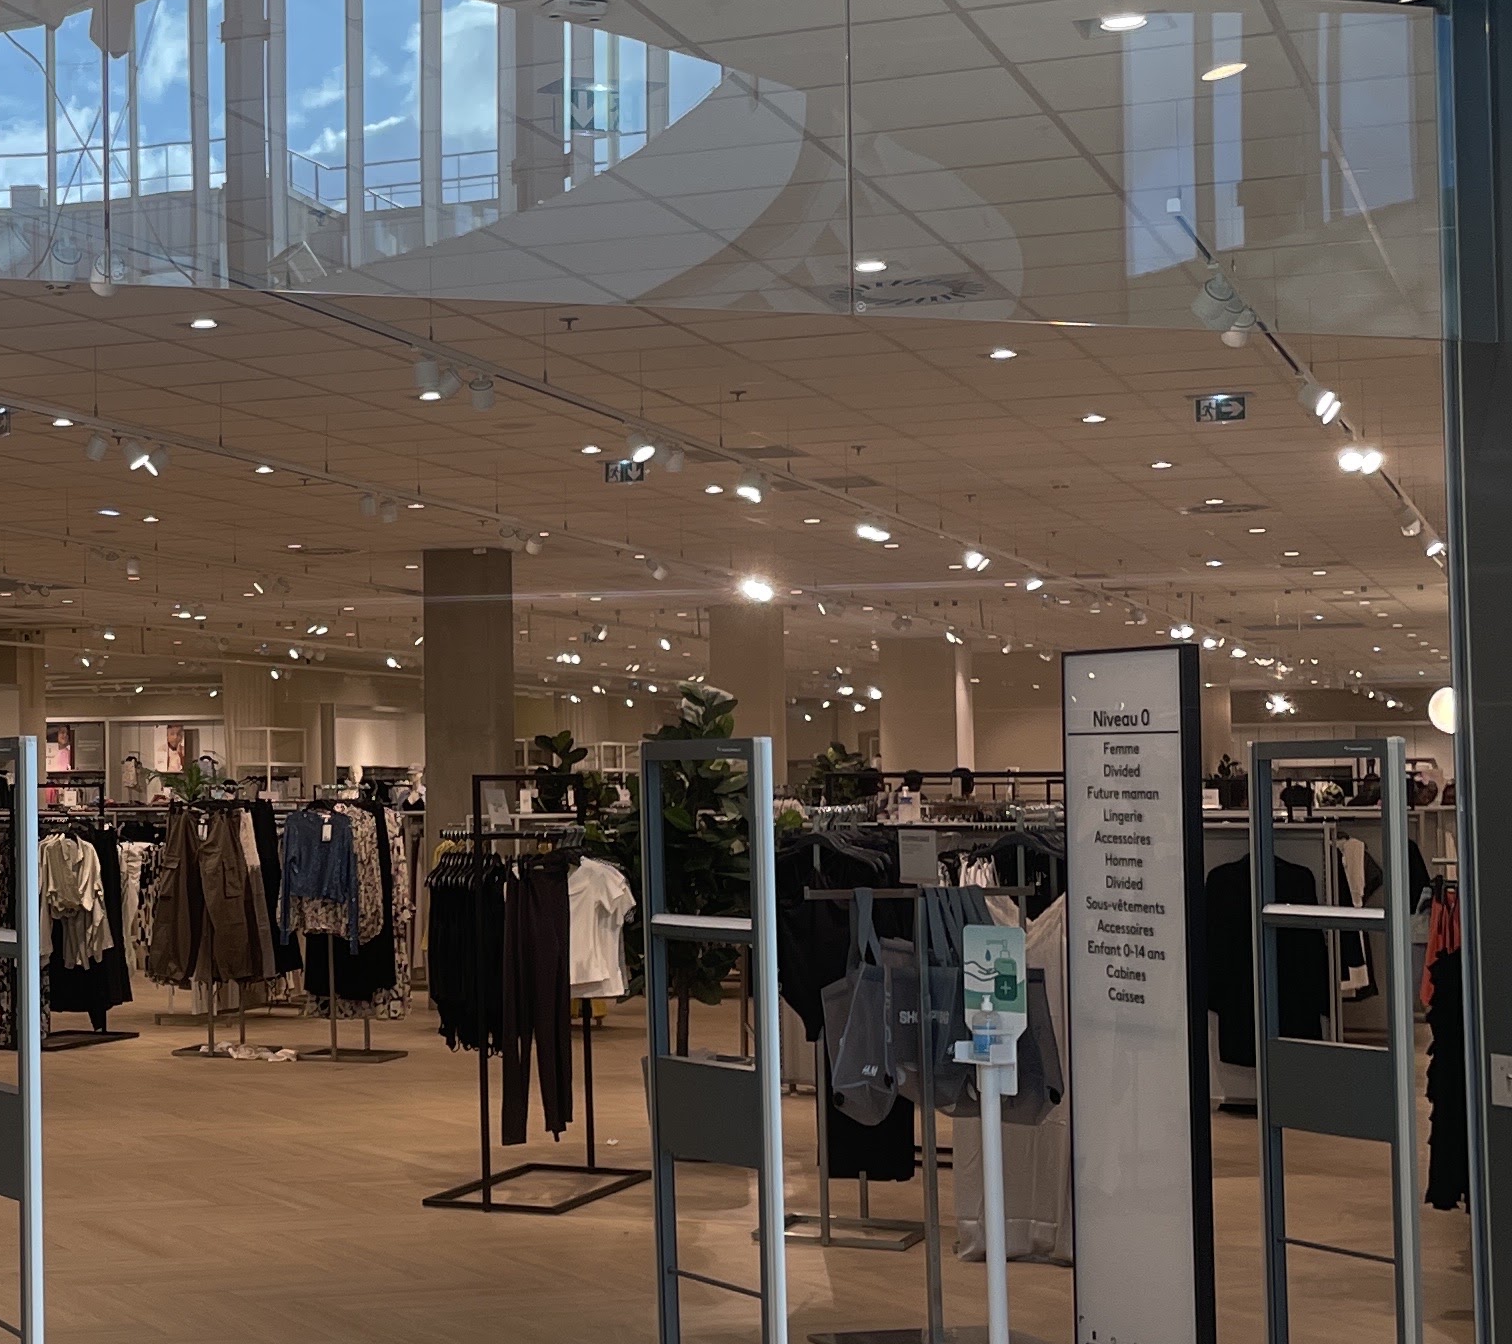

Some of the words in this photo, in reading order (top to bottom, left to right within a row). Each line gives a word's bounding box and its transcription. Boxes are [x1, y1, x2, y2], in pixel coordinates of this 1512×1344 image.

[1093, 710, 1138, 728] Niveau
[1141, 708, 1150, 726] 0
[1103, 742, 1140, 754] Femme
[1103, 763, 1141, 777] Divided
[1087, 785, 1120, 799] Future
[1121, 790, 1159, 800] maman
[1103, 808, 1143, 825] Lingerie
[1094, 830, 1152, 845] Accessoires
[1104, 853, 1143, 868] Homme
[1105, 875, 1144, 890] Divided
[1086, 896, 1166, 915] Sous-vêtements
[1097, 919, 1155, 937] Accessoires
[1087, 940, 1122, 956] Enfant
[1123, 943, 1146, 958] 0-14
[1147, 949, 1166, 960] ans
[1106, 964, 1147, 982] Cabines
[1108, 987, 1146, 1005] Caisses
